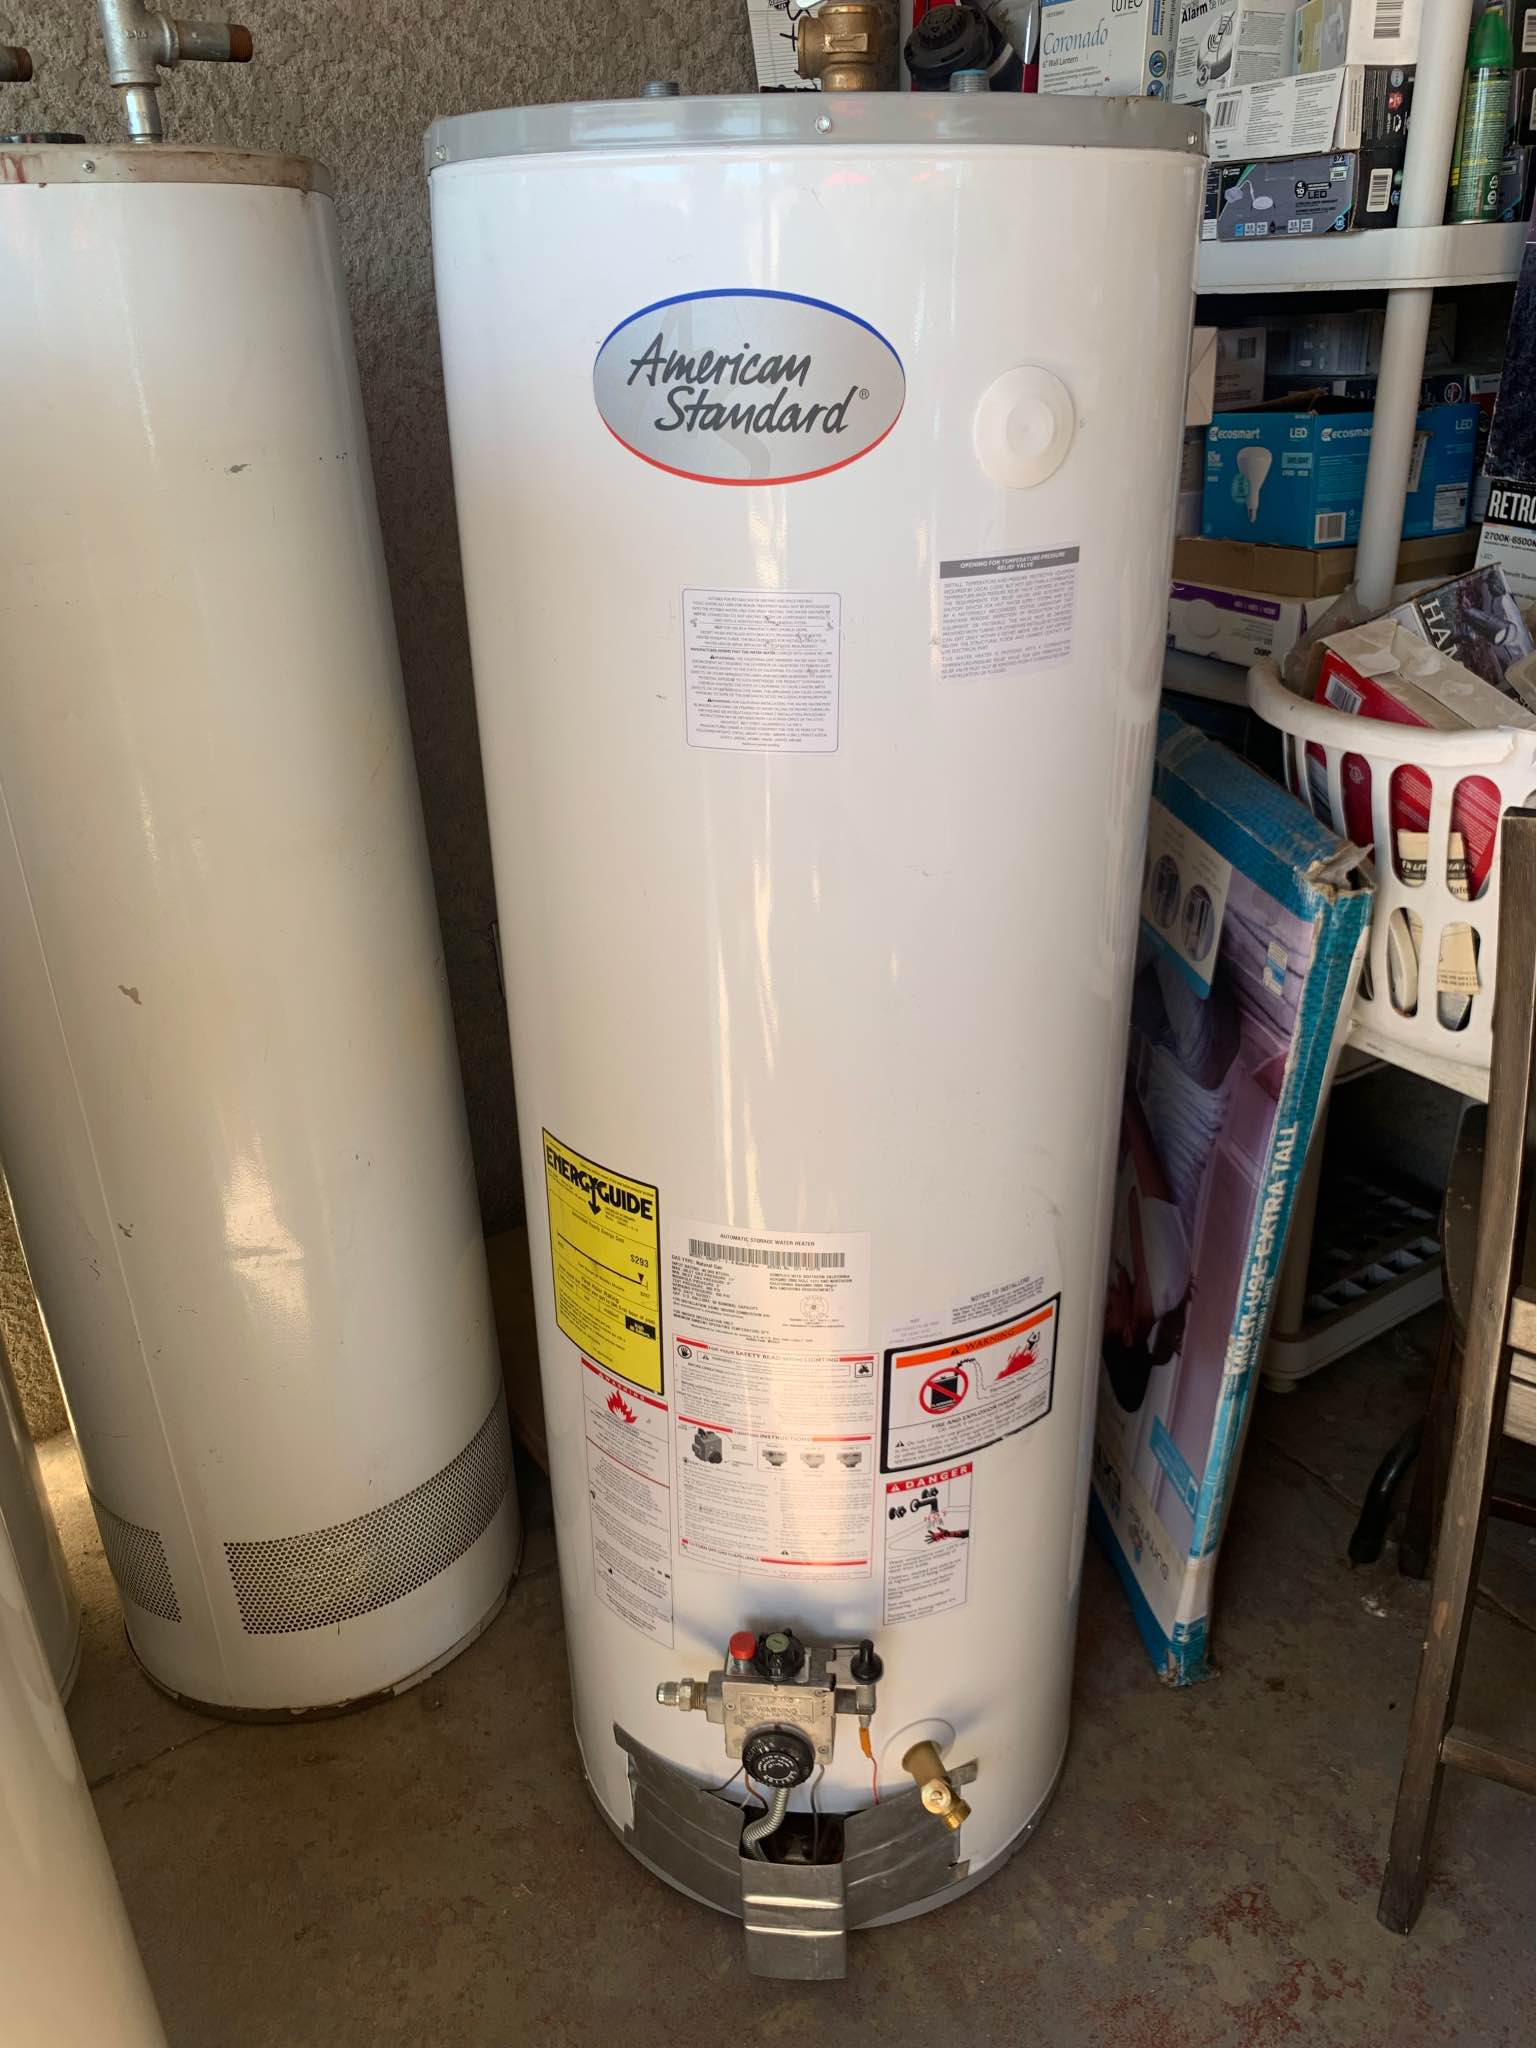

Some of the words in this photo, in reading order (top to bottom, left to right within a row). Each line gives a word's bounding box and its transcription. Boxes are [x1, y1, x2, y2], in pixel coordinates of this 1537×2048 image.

[1181, 3, 1208, 24] Alarm
[1043, 18, 1109, 56] Coronado
[1048, 59, 1059, 67] Wall
[1059, 56, 1079, 65] Lantern
[1307, 190, 1328, 200] LED
[627, 332, 812, 387] American
[654, 385, 859, 434] Standard
[1455, 418, 1473, 431] LED
[1217, 428, 1261, 440] ecosmart
[1289, 427, 1308, 439] LED
[960, 560, 988, 570] OPENING
[988, 559, 1001, 567] FOR
[996, 564, 1016, 572] RELIEF
[1016, 561, 1034, 569] VALVE
[546, 1144, 653, 1221] ENERGYGUIDE
[1255, 1178, 1287, 1256] EXTRA
[1271, 1120, 1298, 1175] TALL
[719, 1233, 750, 1243] AUTOMATIC
[630, 1254, 649, 1268] $293
[671, 1254, 681, 1262] GAS
[695, 1260, 713, 1269] Natural
[970, 1290, 991, 1302] NOTICE
[965, 1327, 1016, 1351] WARNING
[736, 1350, 761, 1359] SAFETY
[761, 1353, 782, 1361] READ
[931, 1421, 946, 1430] FIRE
[947, 1416, 962, 1425] AND
[962, 1404, 998, 1422] EXPLOSION
[760, 1434, 810, 1442] INSTRUCTIONS
[905, 1465, 968, 1489] DANGER
